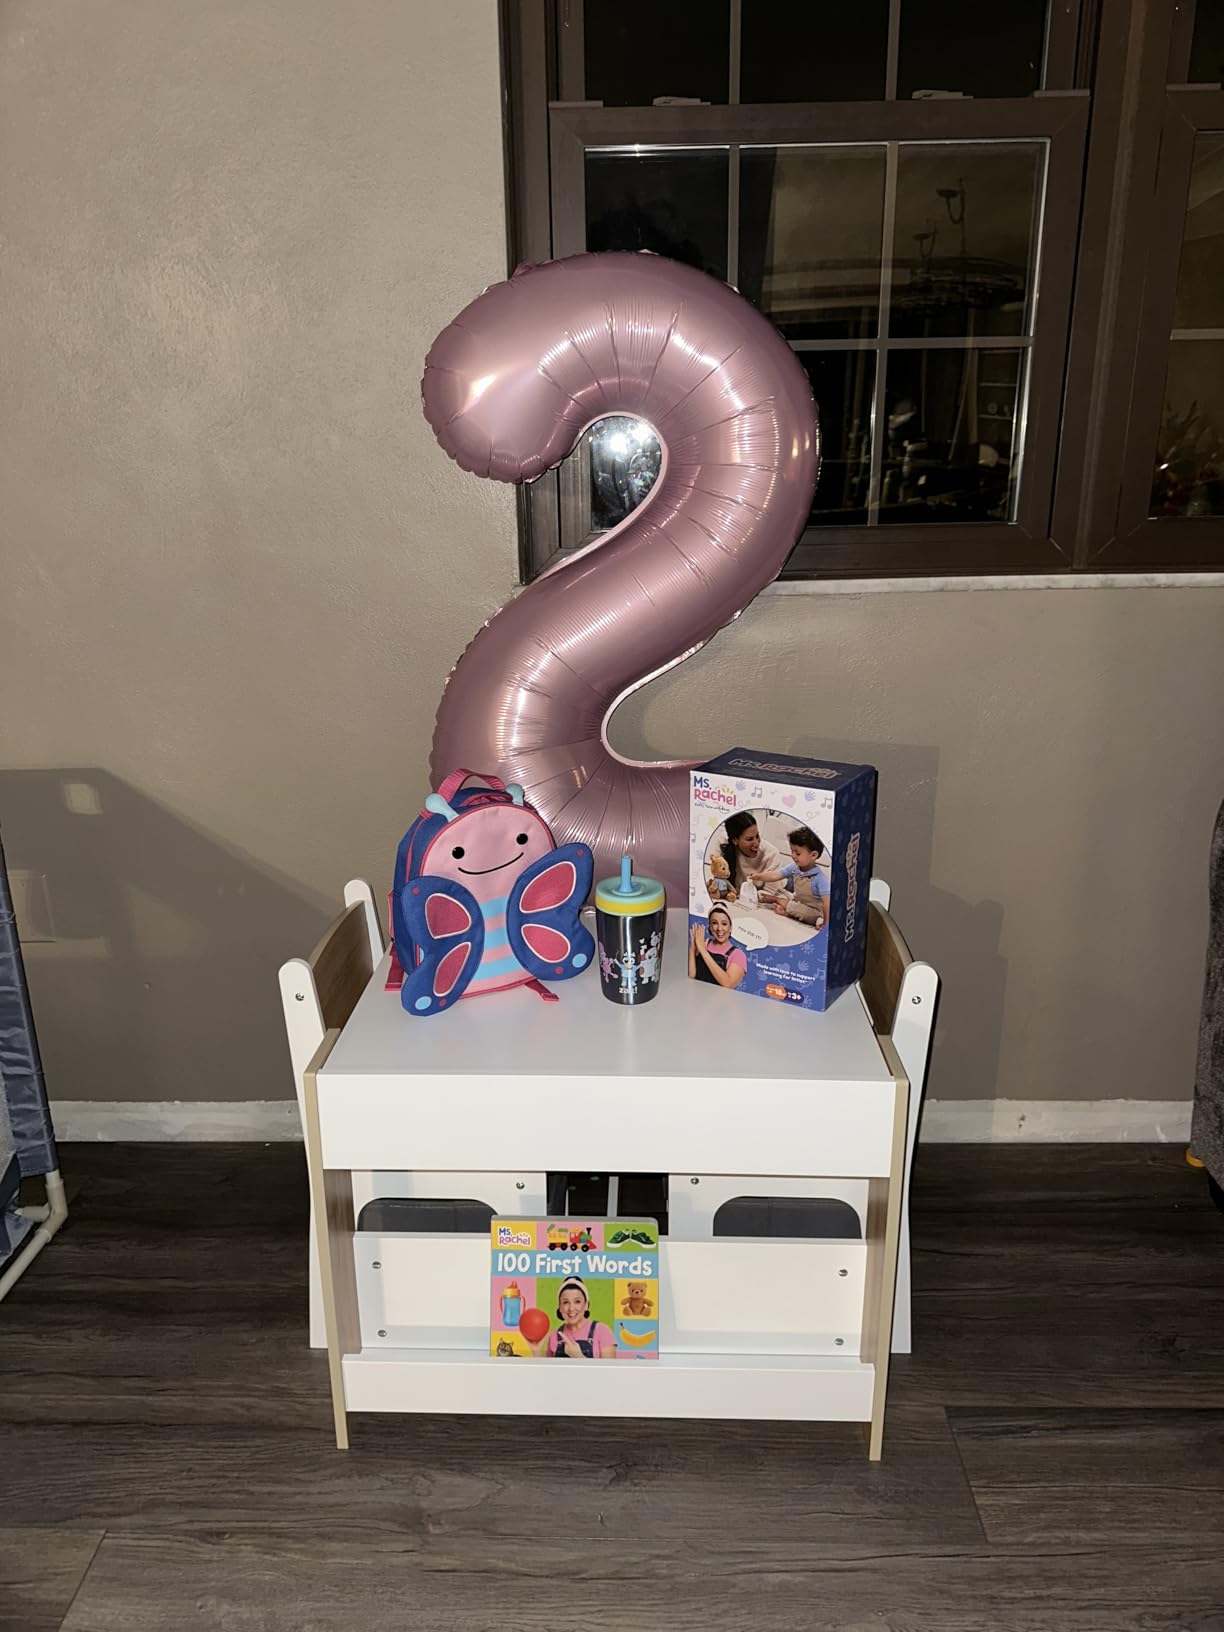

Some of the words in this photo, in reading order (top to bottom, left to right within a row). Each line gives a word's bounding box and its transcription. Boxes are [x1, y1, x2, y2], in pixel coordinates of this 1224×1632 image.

[421, 247, 822, 910] 2
[693, 775, 712, 790] Ms.
[693, 788, 737, 807] Rachel
[498, 1234, 531, 1246] Rachel
[497, 1253, 531, 1273] 100
[535, 1254, 582, 1275] First
[586, 1256, 653, 1276] Words
